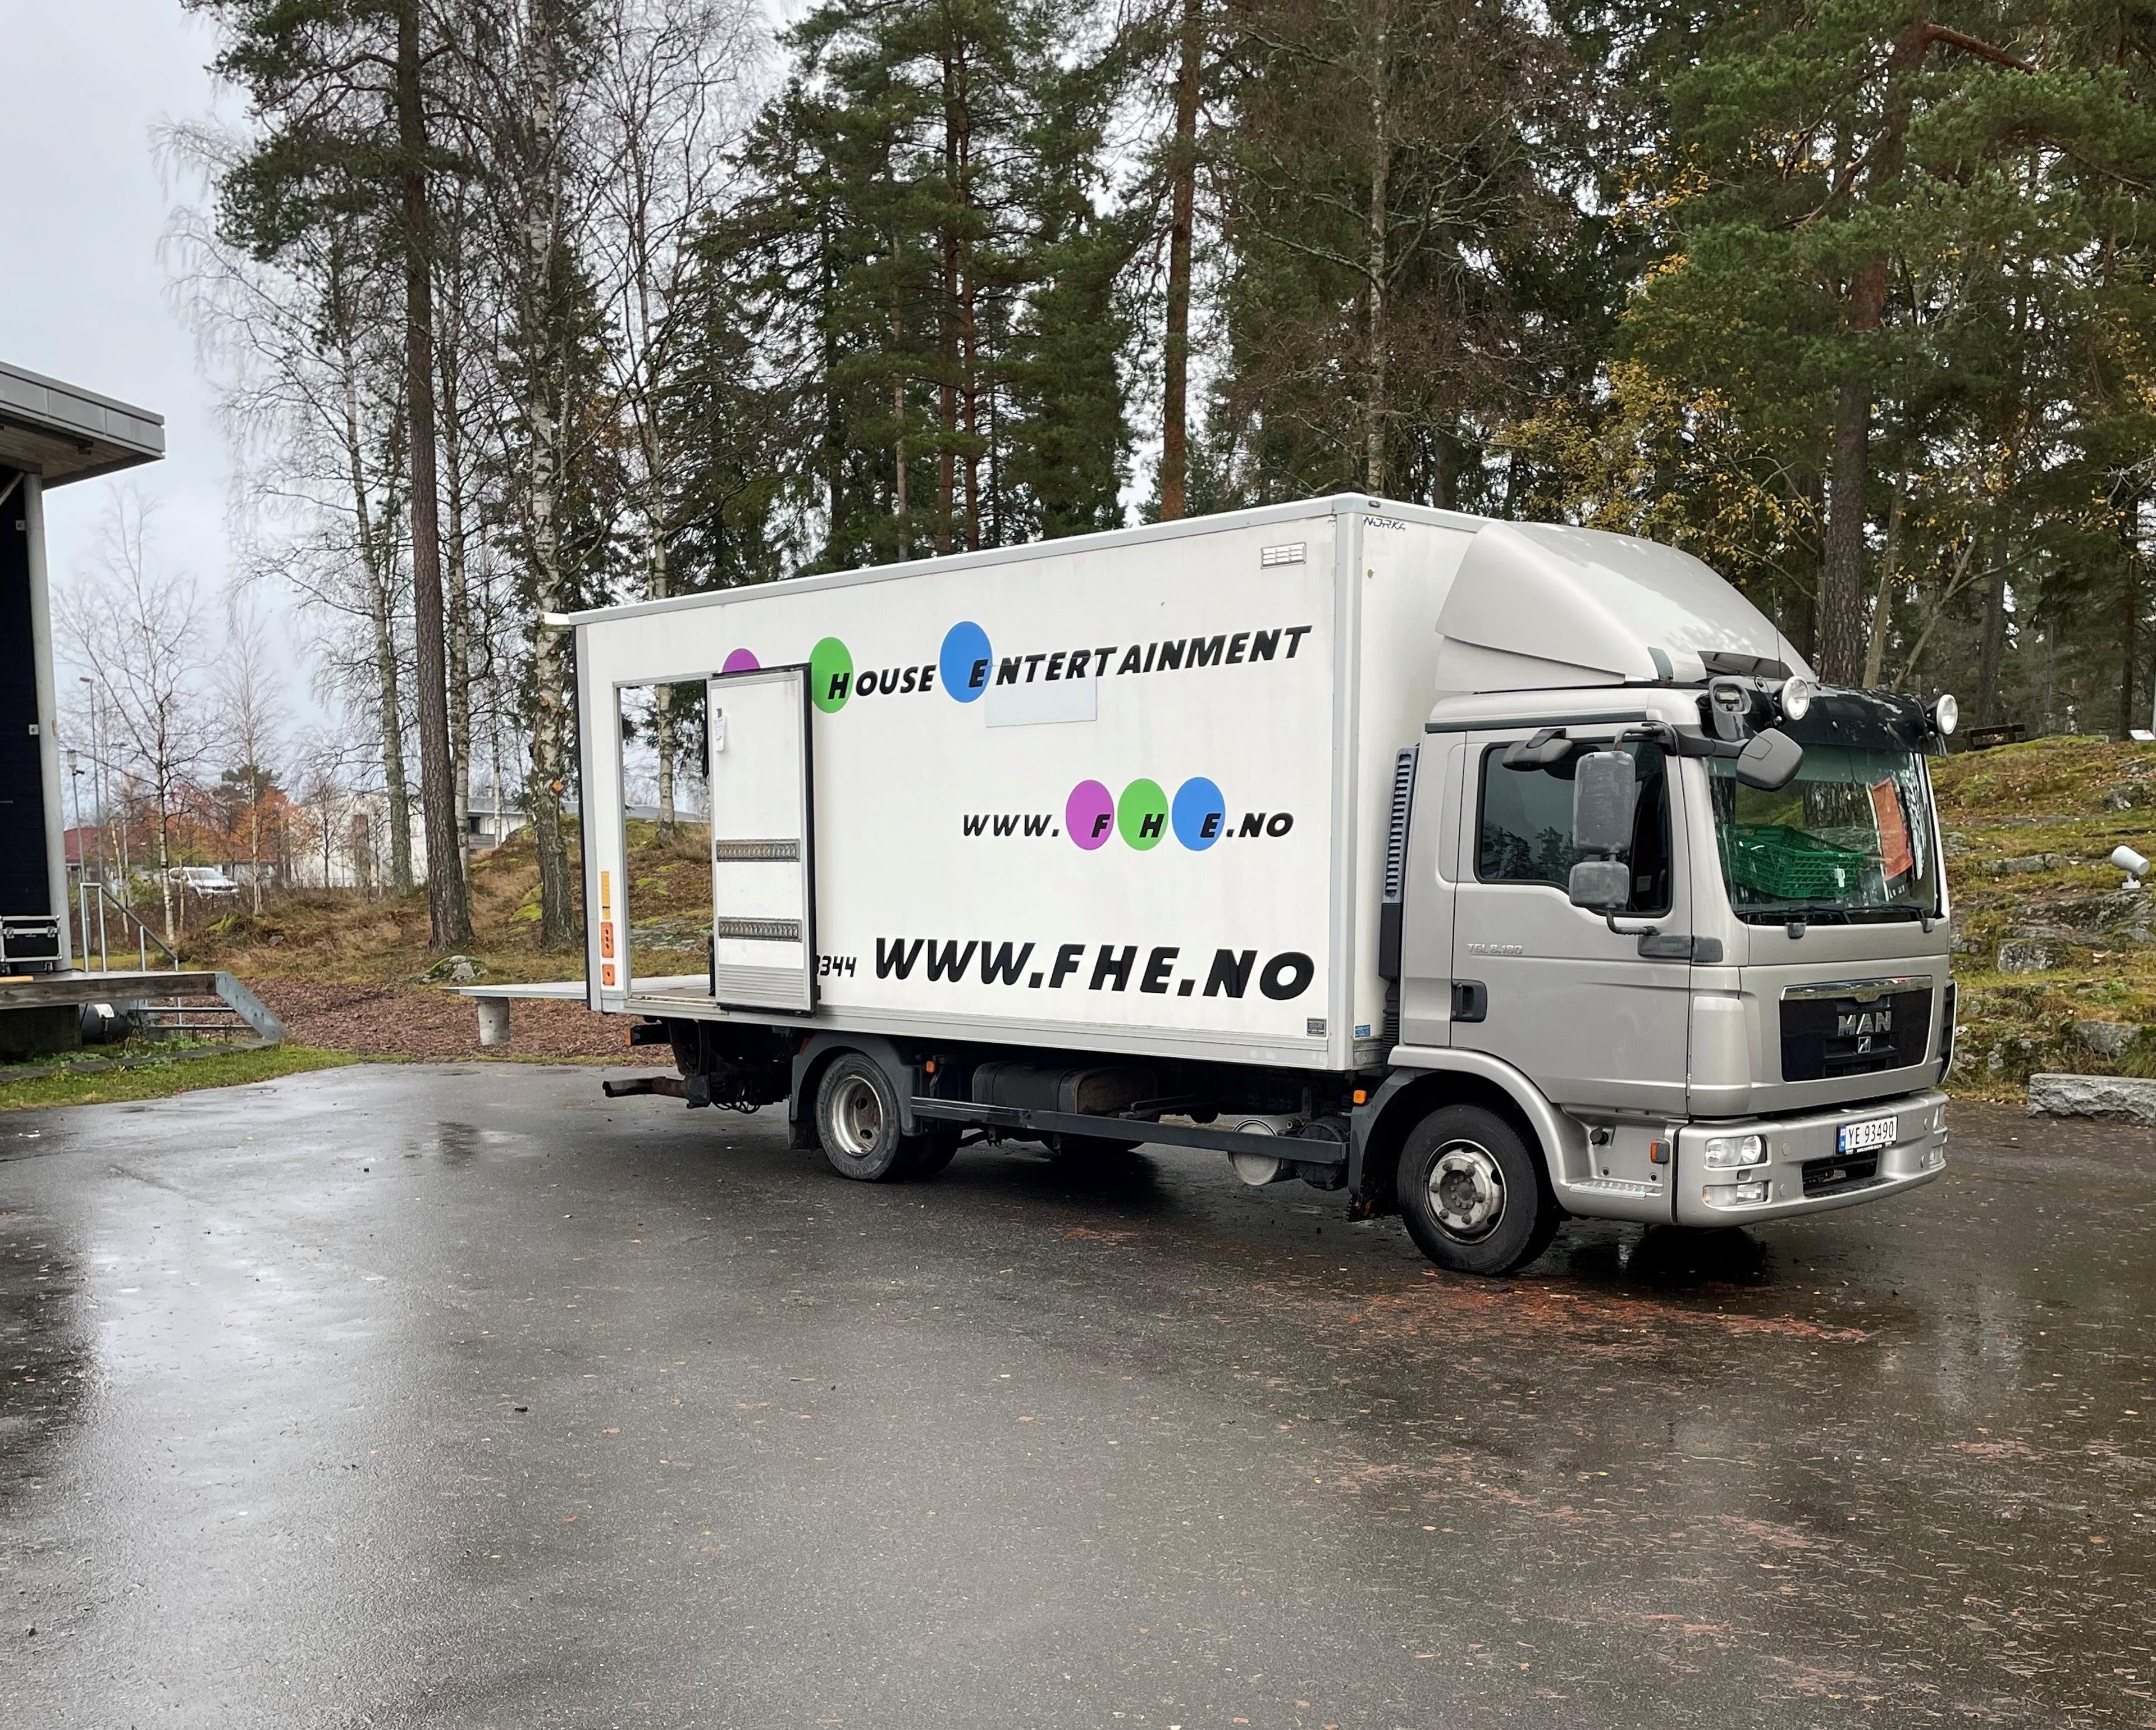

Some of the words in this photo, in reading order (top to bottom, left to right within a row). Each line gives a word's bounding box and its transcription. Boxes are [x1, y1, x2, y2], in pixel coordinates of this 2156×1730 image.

[828, 664, 937, 700] HOUSE
[969, 626, 1313, 688] ENTERTAINMENT
[1467, 943, 1488, 953] TGL
[816, 955, 857, 977] 344
[876, 938, 1314, 1001] WWW.FHE.NO
[1838, 1011, 1892, 1037] MAN
[1849, 1127, 1860, 1145] YE
[1865, 1121, 1894, 1143] 93490
